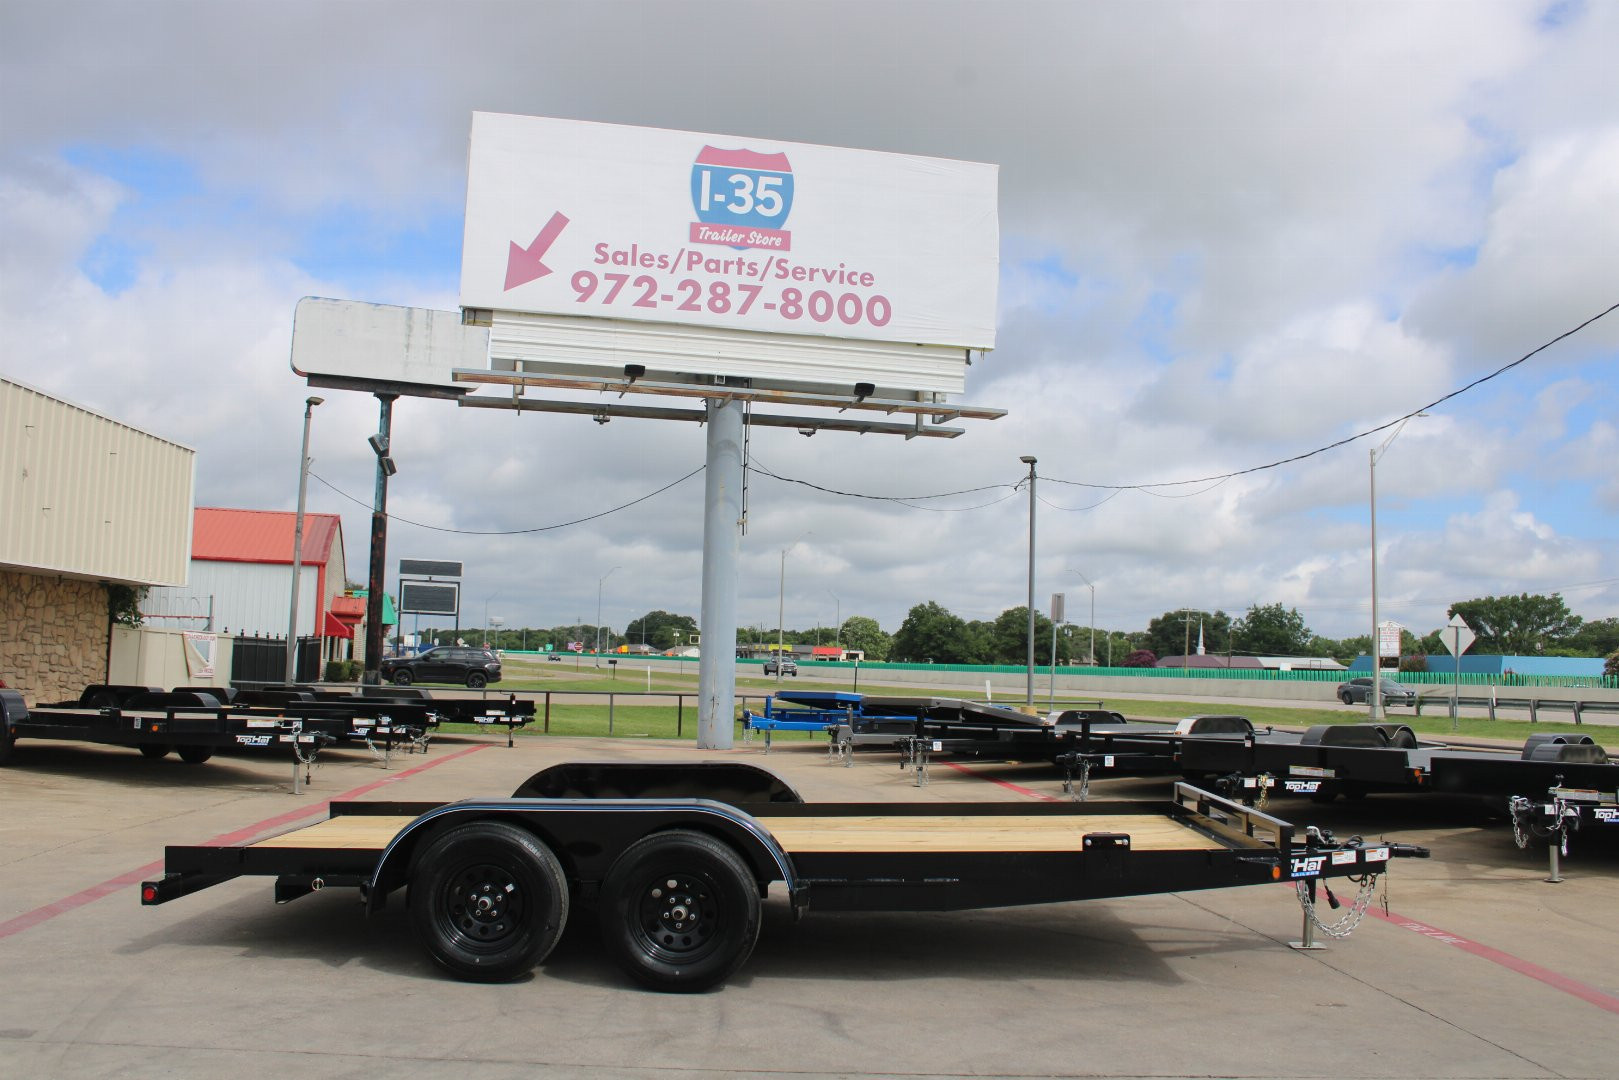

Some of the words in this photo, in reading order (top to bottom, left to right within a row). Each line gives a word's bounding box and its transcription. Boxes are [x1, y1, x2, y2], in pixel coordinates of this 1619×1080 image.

[700, 170, 784, 217] I-35
[699, 227, 745, 243] Trailer
[747, 231, 782, 247] Store
[594, 242, 875, 287] Sales/Parts/Service
[570, 270, 892, 327] 972-287-8000
